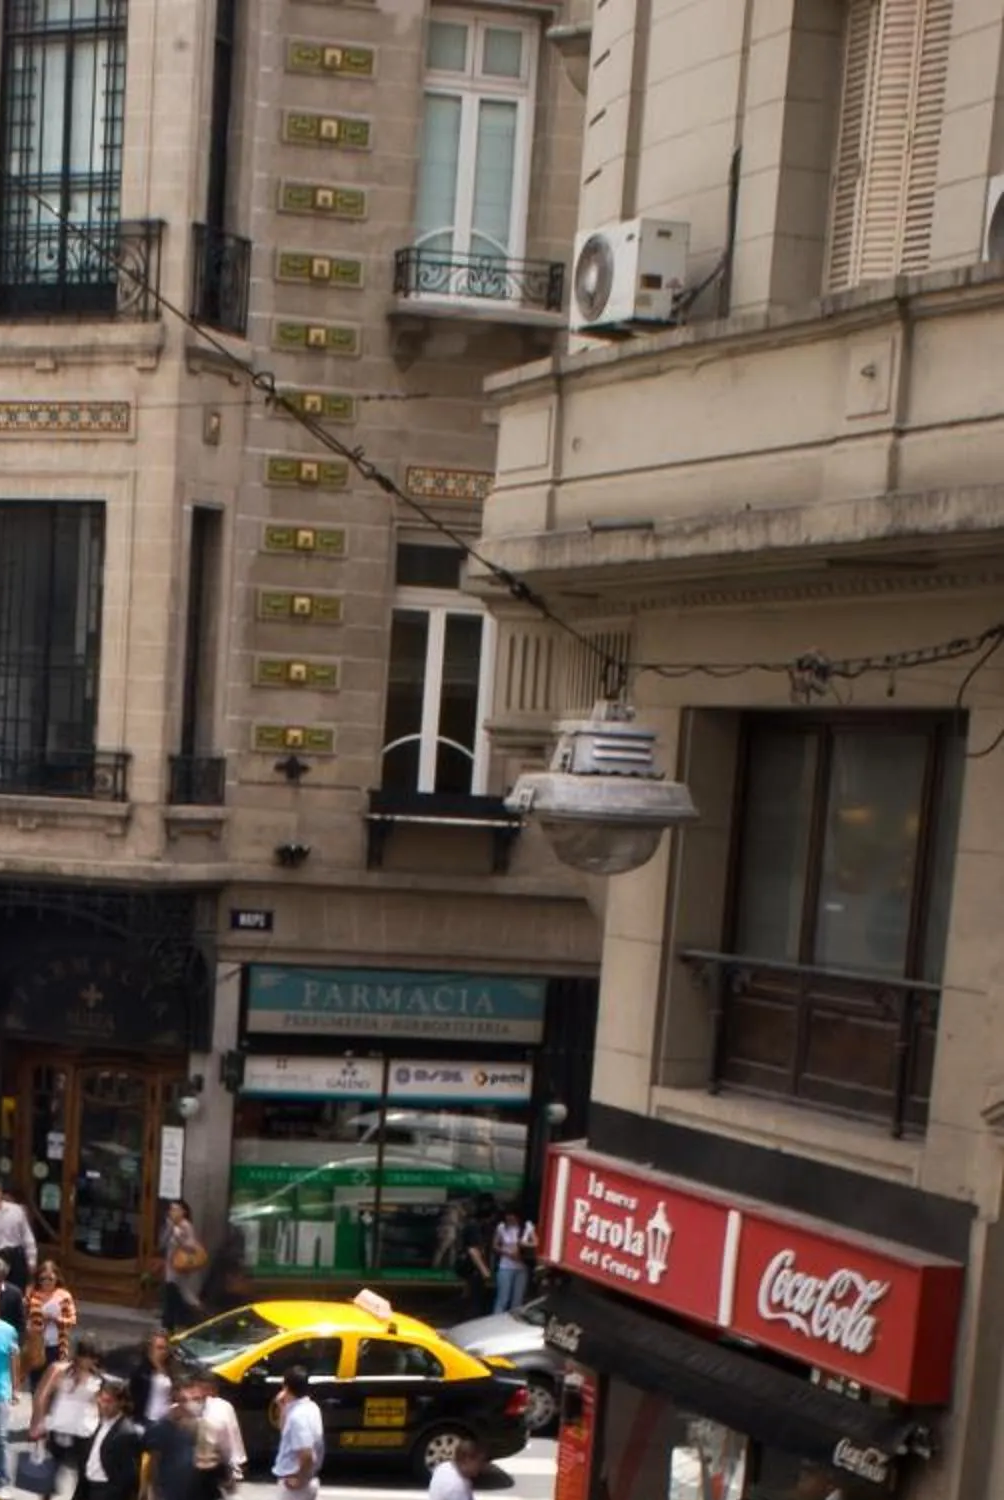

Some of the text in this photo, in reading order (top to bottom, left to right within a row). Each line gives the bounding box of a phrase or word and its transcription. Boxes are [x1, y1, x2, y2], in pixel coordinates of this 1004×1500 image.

[302, 980, 494, 1015] FARMACIA
[572, 1198, 645, 1257] Farola
[579, 1245, 600, 1266] del
